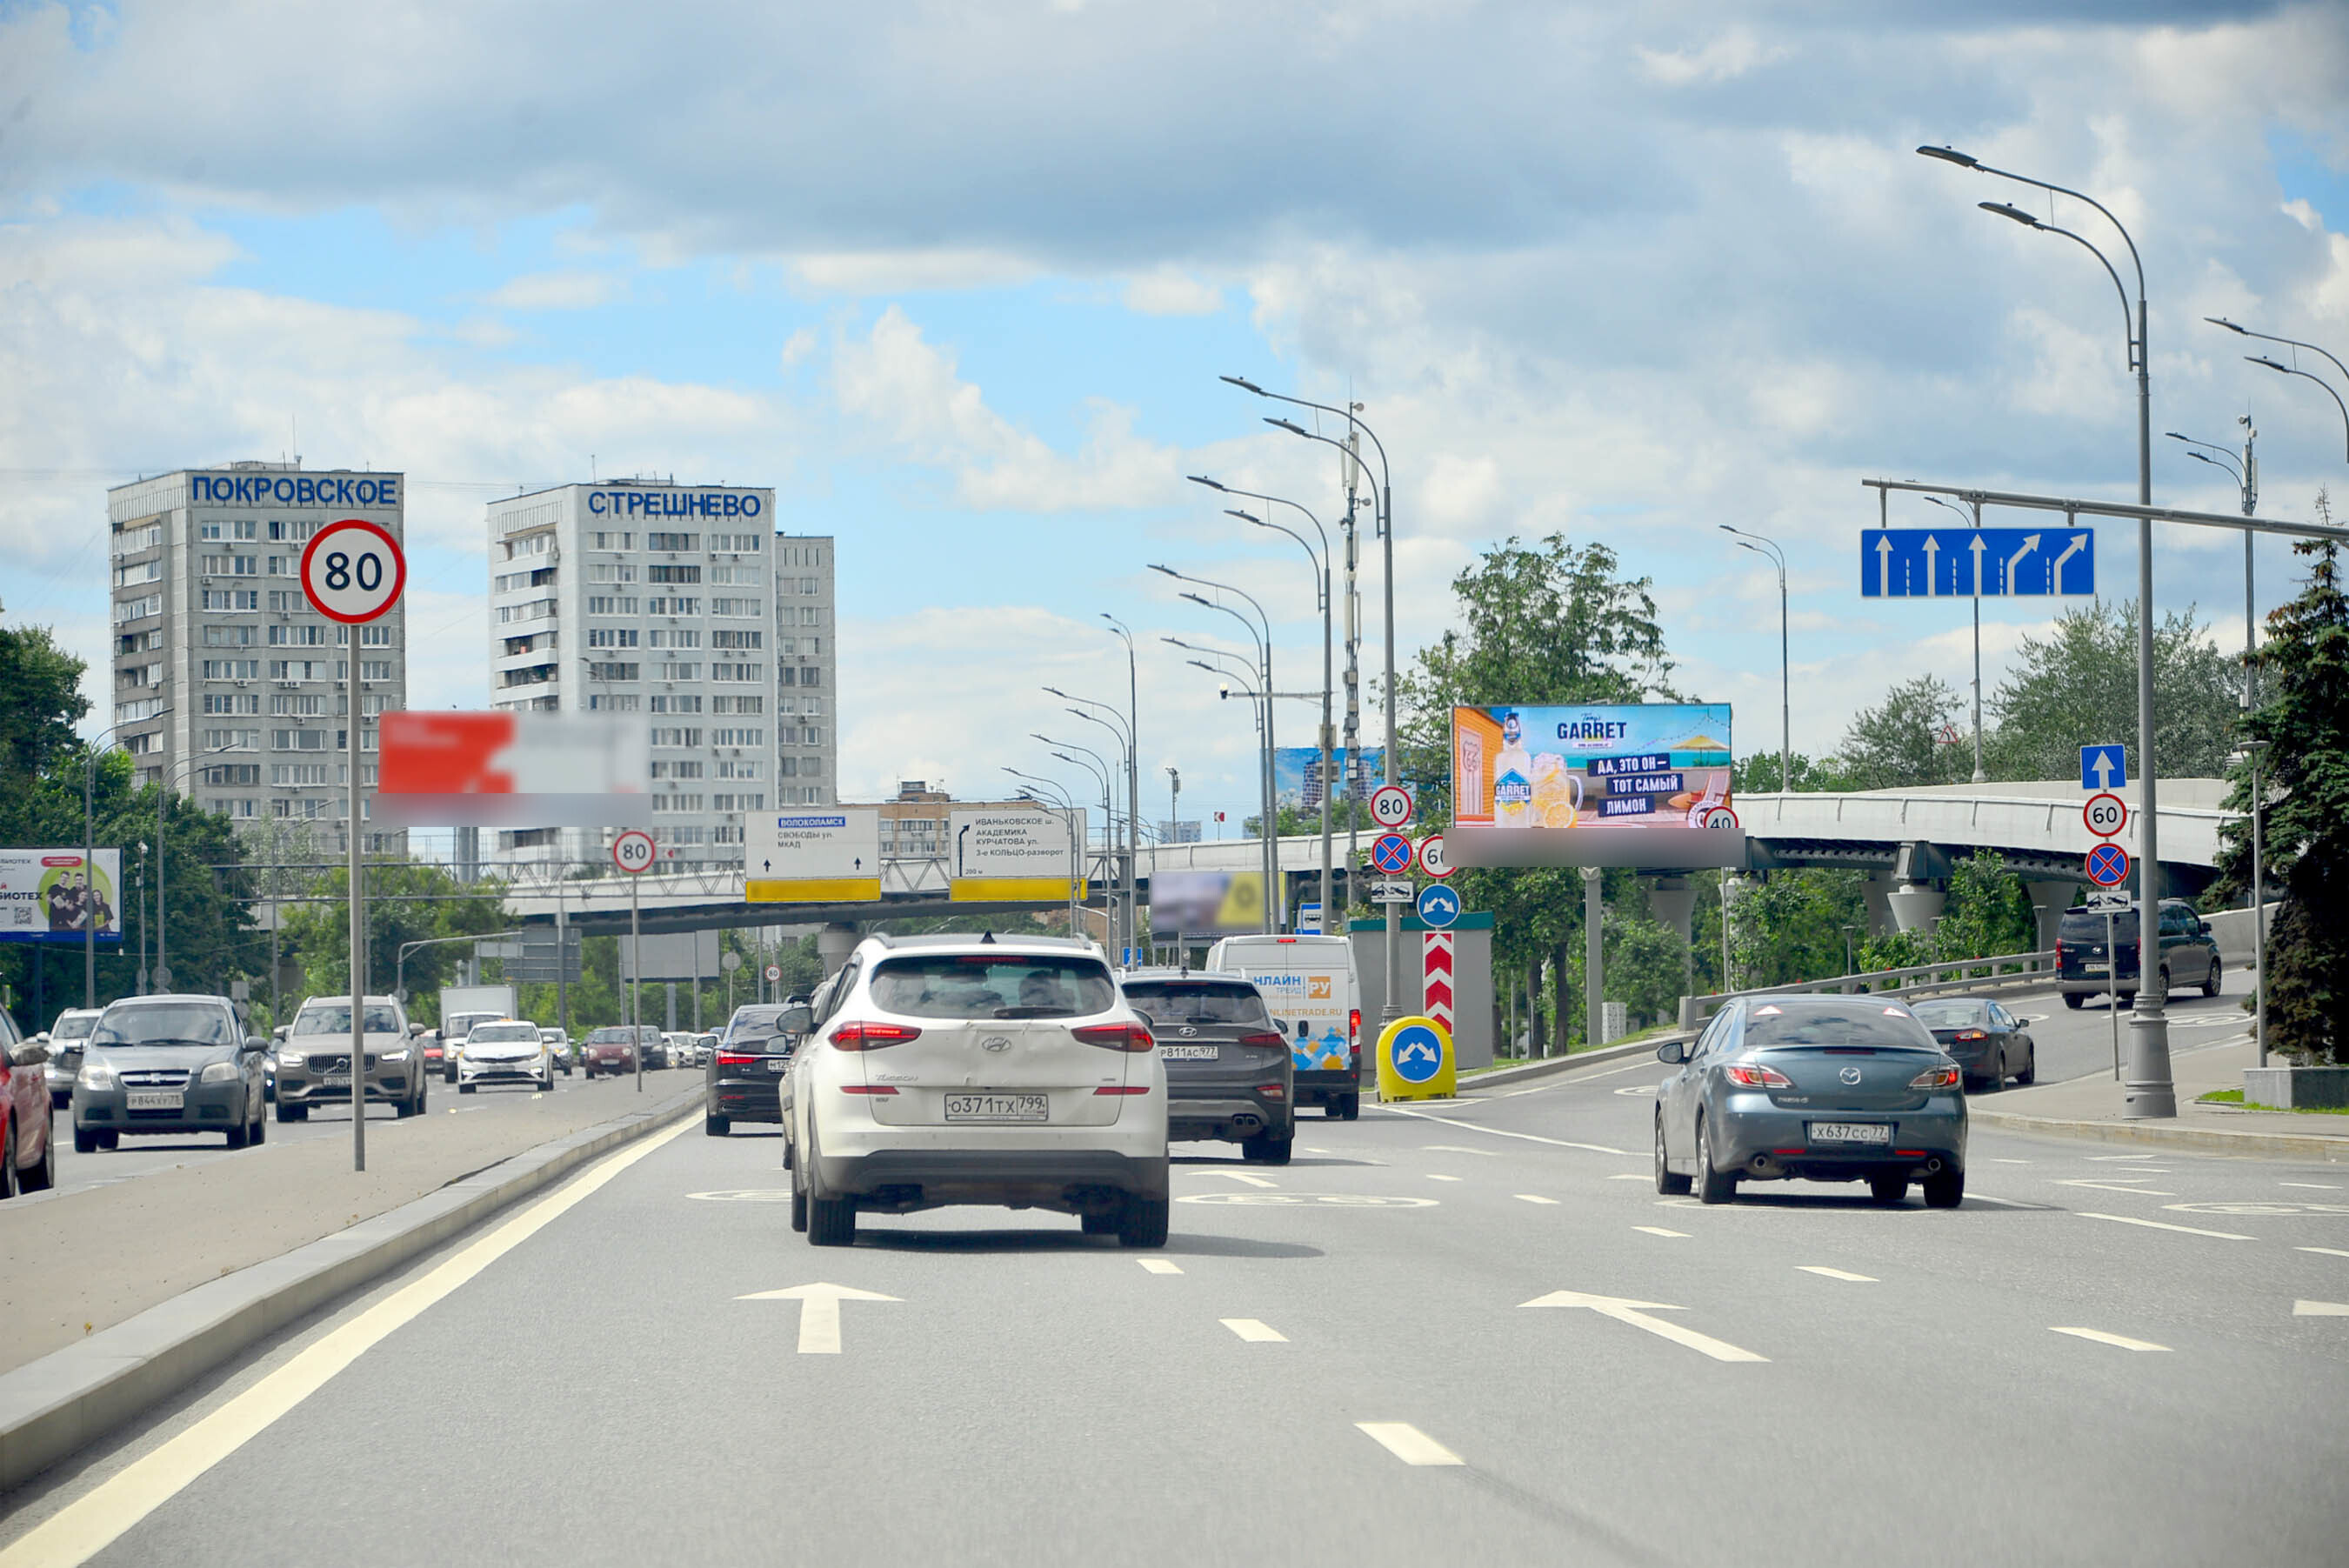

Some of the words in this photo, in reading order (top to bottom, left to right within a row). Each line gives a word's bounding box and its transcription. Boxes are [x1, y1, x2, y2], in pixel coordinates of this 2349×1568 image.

[192, 476, 397, 505] ПОКРОВСКОЕ
[588, 491, 761, 517] СТРЕШНЕВО
[325, 551, 383, 591] 80
[1557, 722, 1627, 739] GARRET
[1619, 757, 1639, 772] ЭТО
[1495, 784, 1531, 796] GARRET
[1612, 778, 1632, 793] ТОТ
[1635, 774, 1678, 792] САМЫЙ
[1379, 798, 1403, 815] 80
[1606, 797, 1646, 815] ЛИМОН
[780, 817, 844, 827] ВОЛОКОЛАМСК
[975, 817, 1044, 826] ИВАНЬКОВСКОЕ
[2092, 806, 2118, 824] 60
[777, 831, 820, 839] СВОБОДЫ
[976, 828, 1027, 837] АКАДЕМИКА
[976, 837, 1025, 846] КУРЧАТОВА
[623, 844, 646, 860] 80
[1427, 849, 1444, 864] 6
[1253, 973, 1301, 986] НЛАЙН
[1309, 981, 1330, 995] РУ
[1270, 1008, 1343, 1017] NLINETRADE.RU
[1200, 1046, 1216, 1055] 977
[1018, 1097, 1044, 1109] 799
[1872, 1126, 1885, 1137] 77
